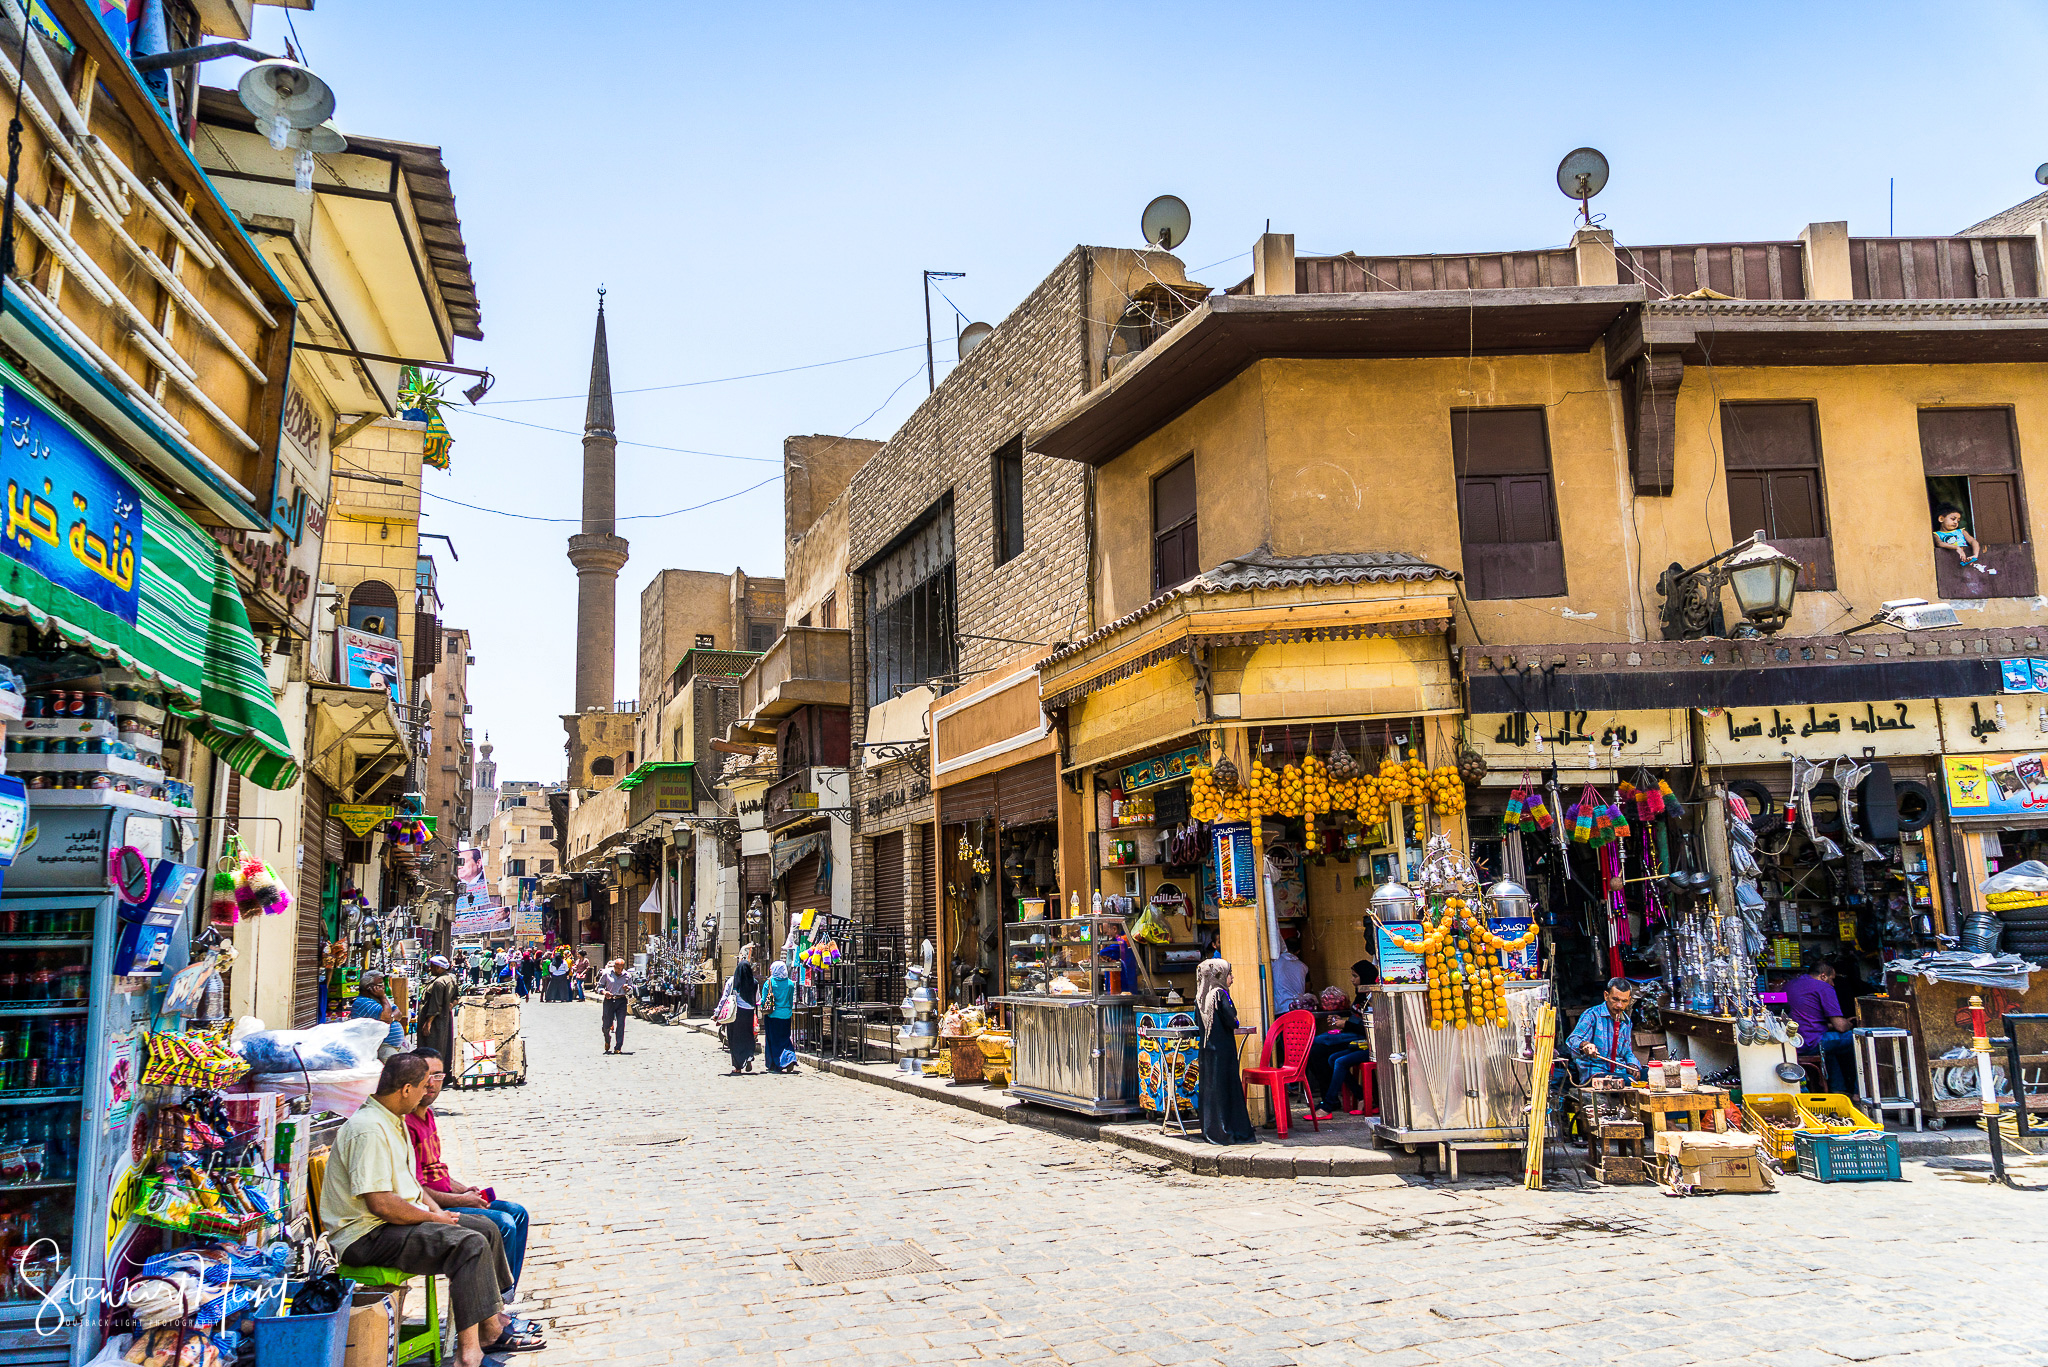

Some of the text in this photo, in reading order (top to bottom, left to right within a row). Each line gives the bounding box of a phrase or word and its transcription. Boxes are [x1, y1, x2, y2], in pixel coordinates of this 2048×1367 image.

[10, 415, 50, 458] ماركت
[7, 481, 60, 551] خير
[69, 494, 135, 592] فتحة
[36, 723, 59, 733] pepsi
[1495, 712, 1529, 747] الله
[1600, 725, 1637, 750] ربيع
[1726, 703, 1915, 744] حداد قطع غيار فسبا
[2022, 791, 2048, 809] يل
